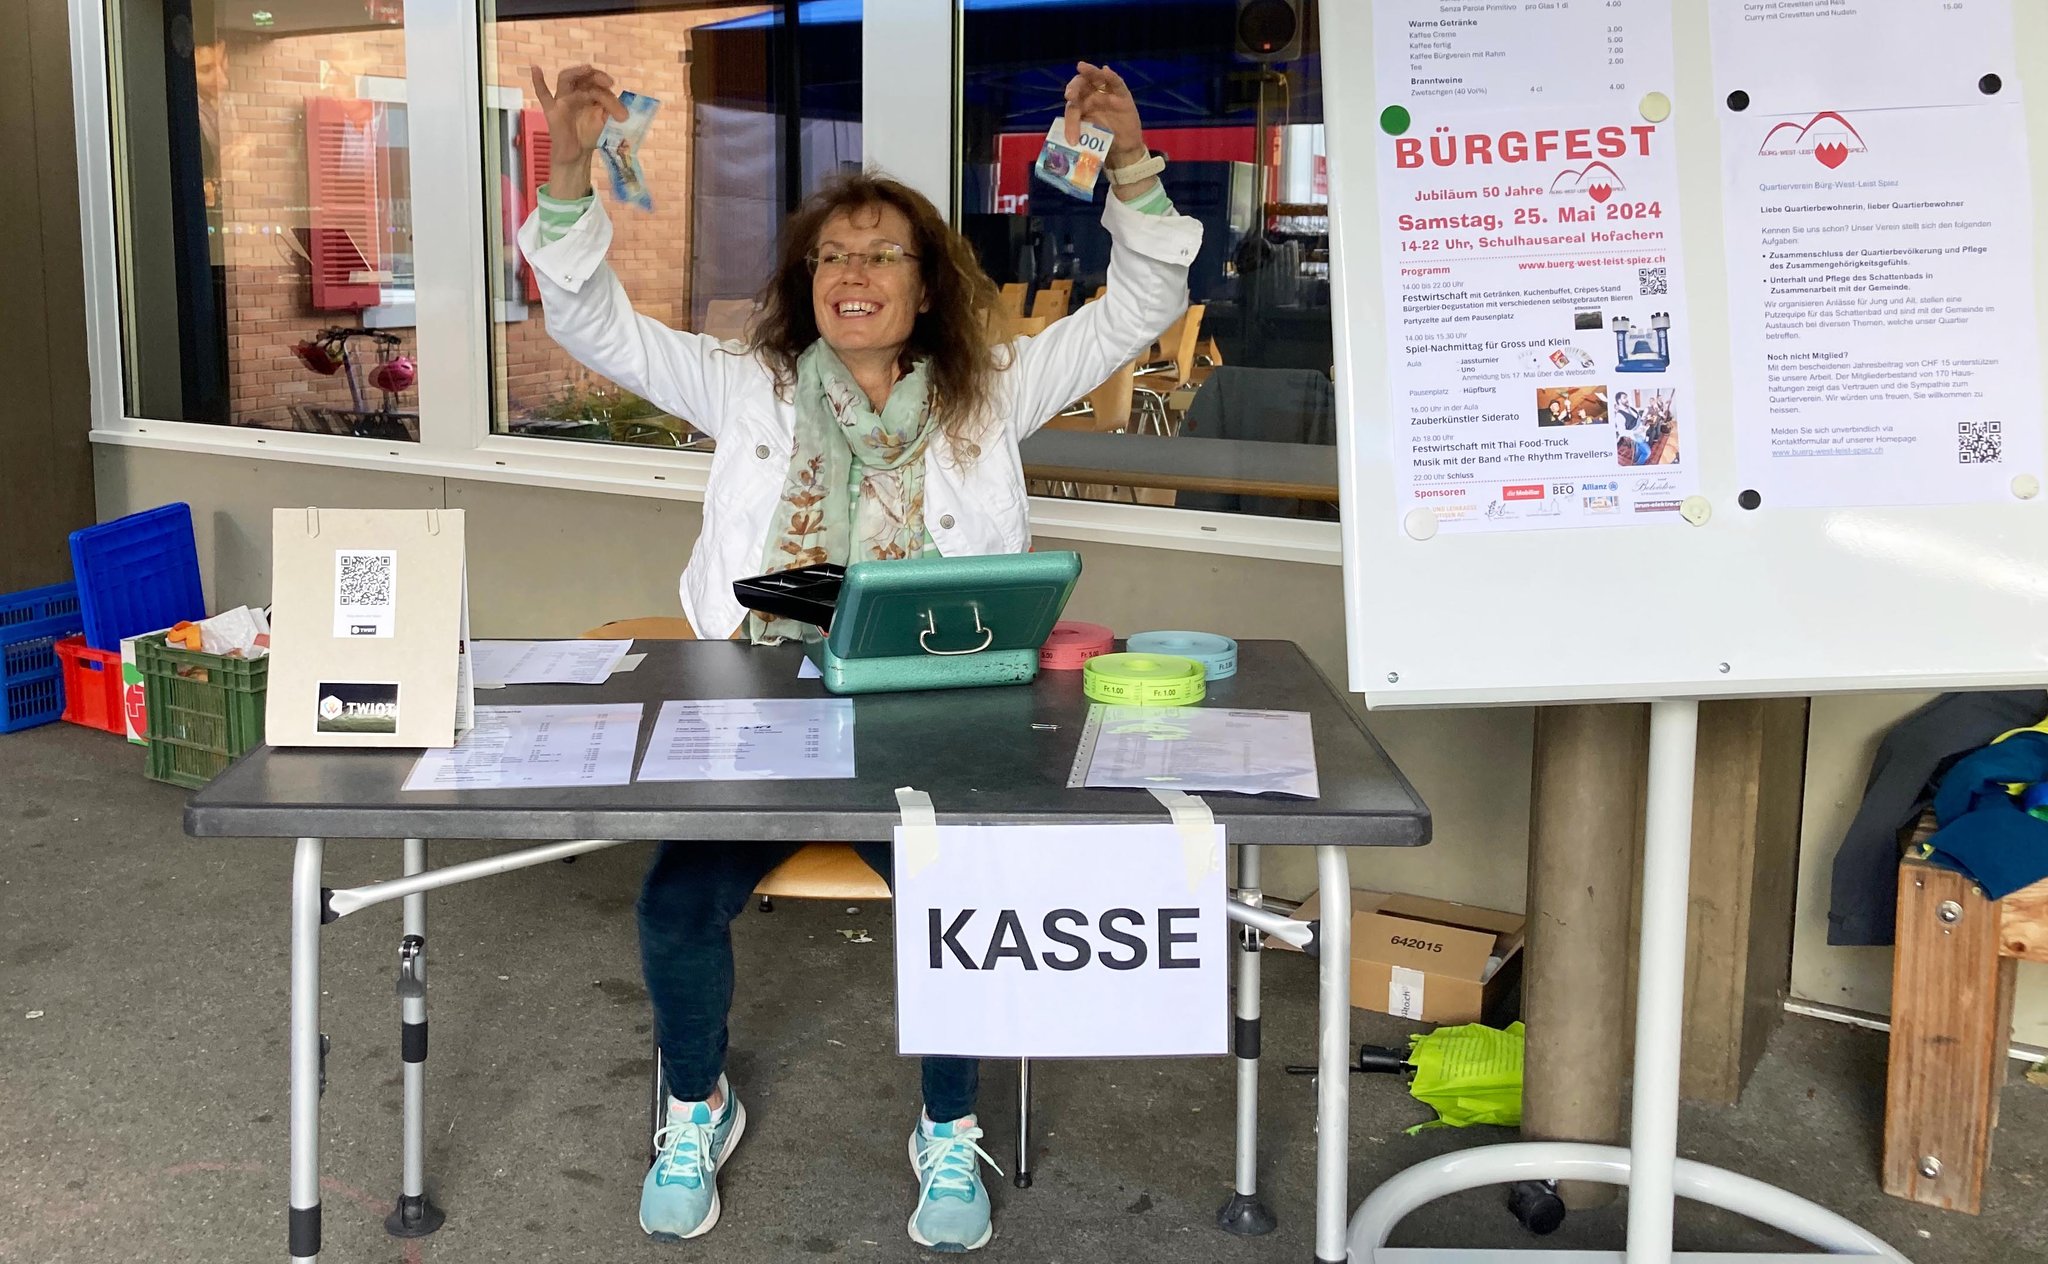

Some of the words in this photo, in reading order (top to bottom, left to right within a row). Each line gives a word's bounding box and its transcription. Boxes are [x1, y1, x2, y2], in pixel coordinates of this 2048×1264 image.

[1079, 133, 1105, 152] 100
[1396, 126, 1656, 168] BÜRGFEST
[1414, 189, 1477, 201] Jubiläum
[1482, 186, 1500, 197] 50
[1504, 185, 1543, 196] Jahre
[1398, 213, 1503, 231] Samstag,
[1514, 207, 1547, 224] 25.
[1558, 205, 1595, 223] Mai
[1606, 201, 1661, 219] 2024
[1401, 239, 1439, 251] 14-22
[1445, 238, 1473, 250] Uhr,
[1478, 232, 1585, 247] Schulhausareal
[1591, 230, 1663, 242] Hofachern
[1768, 250, 1843, 258] Zusammenschluss
[1860, 248, 1942, 256] Quartierbevölkerung
[1962, 245, 1987, 254] Pflege
[1401, 267, 1450, 276] Programm
[1403, 317, 1439, 325] Partyzelte
[1405, 343, 1483, 354] Spiel-Nachmittag
[1485, 341, 1498, 349] für
[1528, 338, 1545, 347] und
[1812, 352, 1848, 360] Mitglied?
[1410, 414, 1479, 425] Zauberkünstler
[1481, 413, 1519, 422] Siderato
[1412, 442, 1478, 452] Festwirtschaft
[1519, 437, 1568, 447] Food-Truck
[1413, 458, 1440, 466] Musik
[1478, 454, 1501, 463] Band
[1527, 452, 1562, 462] Rhythm
[1414, 489, 1465, 498] Sponsoren
[1552, 486, 1574, 494] BEO
[928, 907, 1201, 971] KASSE
[1390, 935, 1443, 953] 642015
